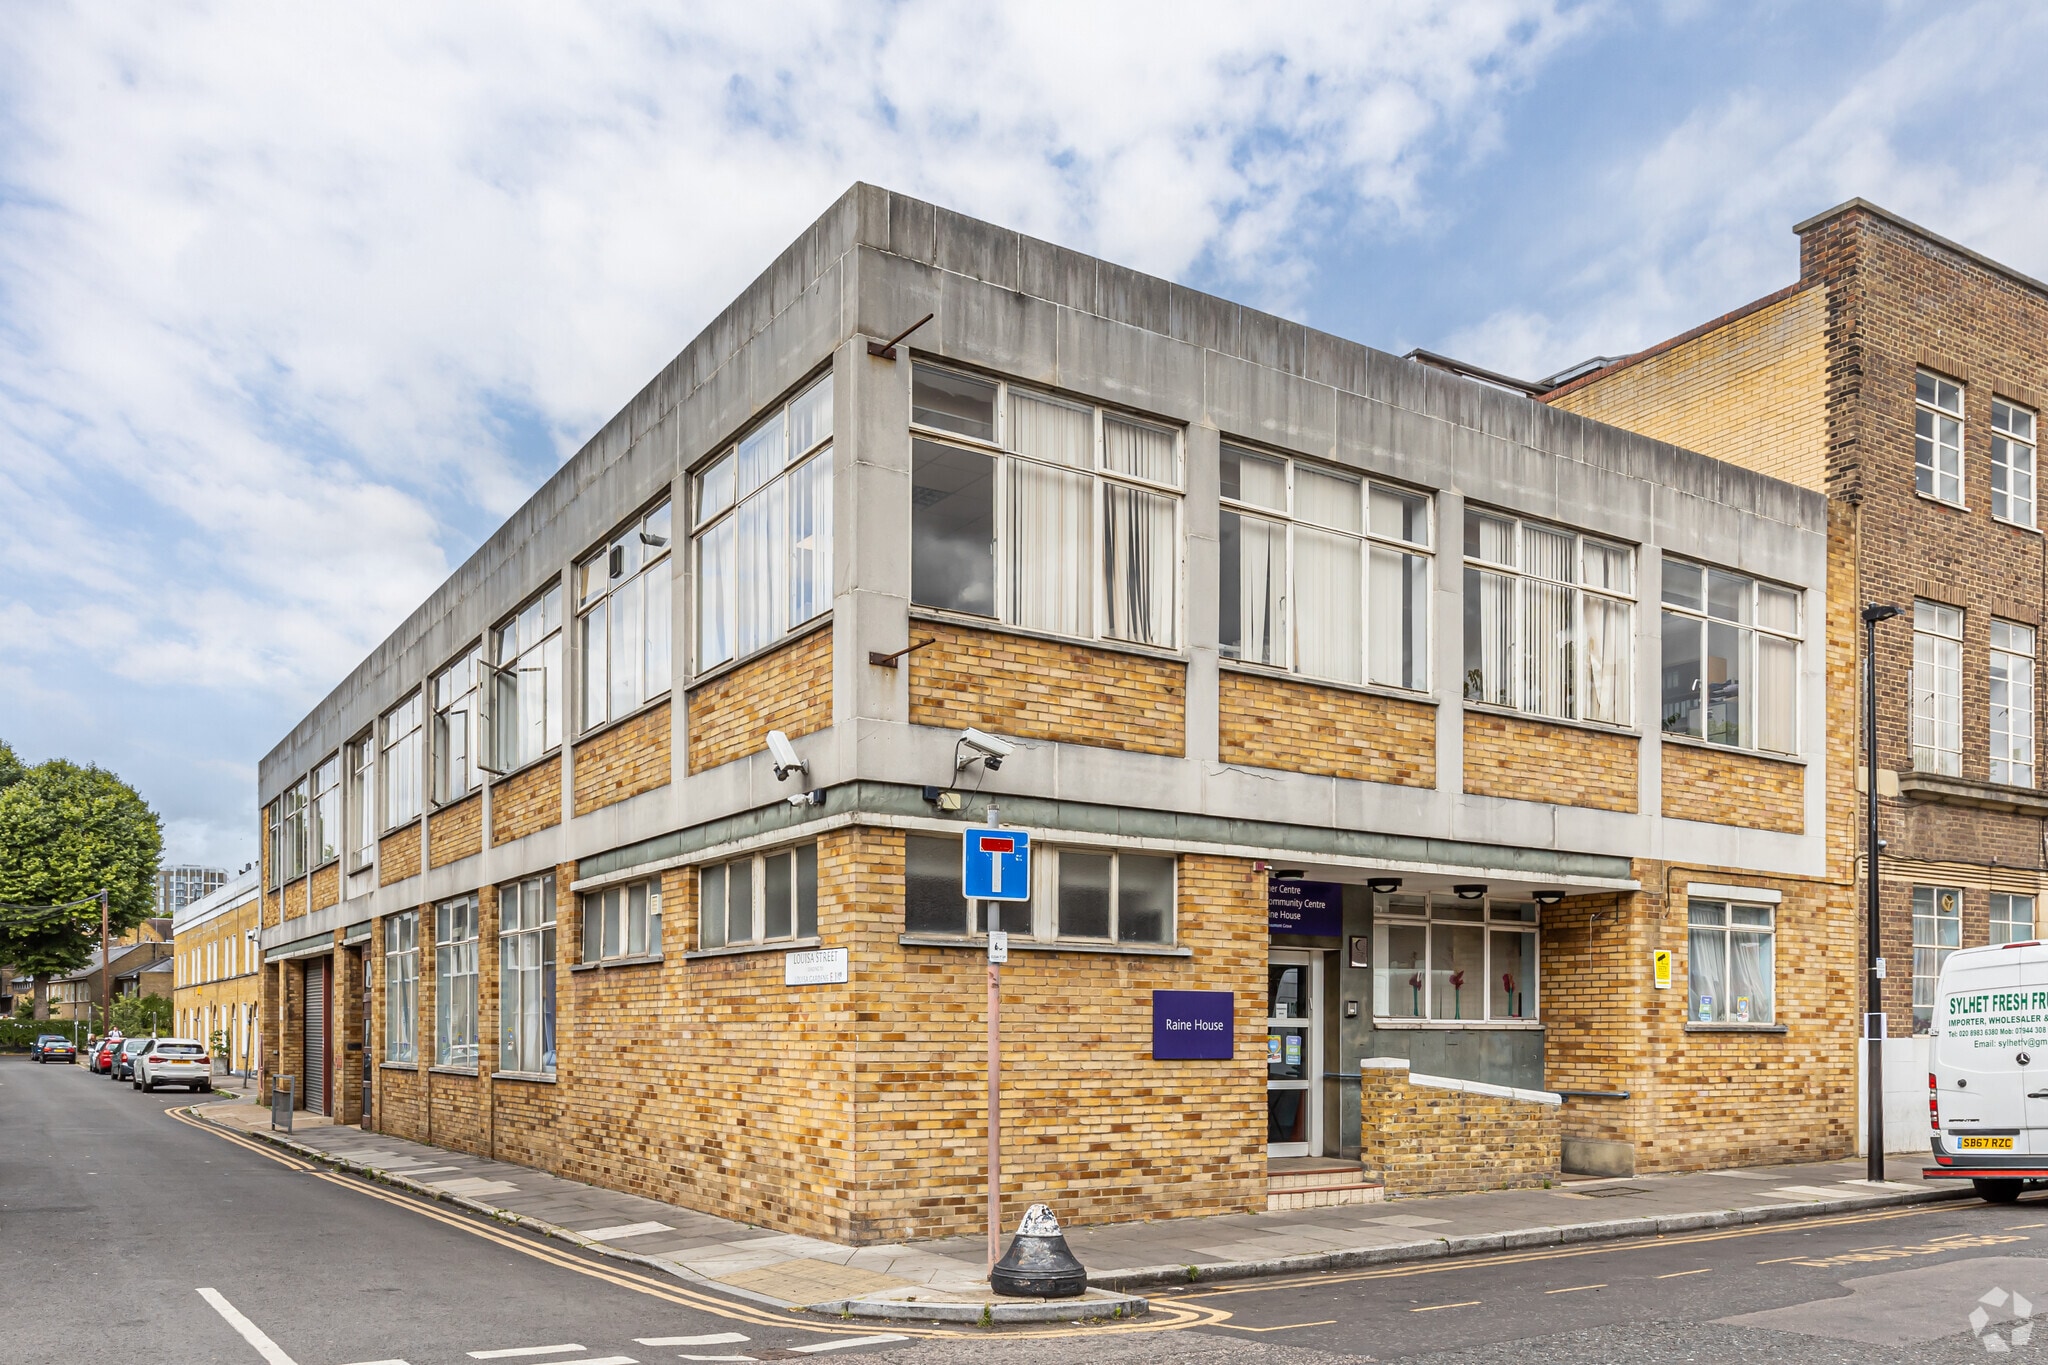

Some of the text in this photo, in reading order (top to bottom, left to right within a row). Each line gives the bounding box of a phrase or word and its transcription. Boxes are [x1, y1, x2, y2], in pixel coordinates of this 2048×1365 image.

[1279, 884, 1301, 894] Centre
[1304, 898, 1326, 908] Centre
[1280, 911, 1301, 920] House
[794, 951, 838, 964] LOUISA STREET
[1950, 992, 2048, 1015] SYLHET FRESH FR
[1166, 1019, 1223, 1030] Raine House
[1948, 1018, 1987, 1026] IMPORTER,
[1989, 1015, 2041, 1024] WHOLESALER
[1974, 1040, 1996, 1048] Email:
[1964, 1138, 2011, 1148] SB67 RZC
